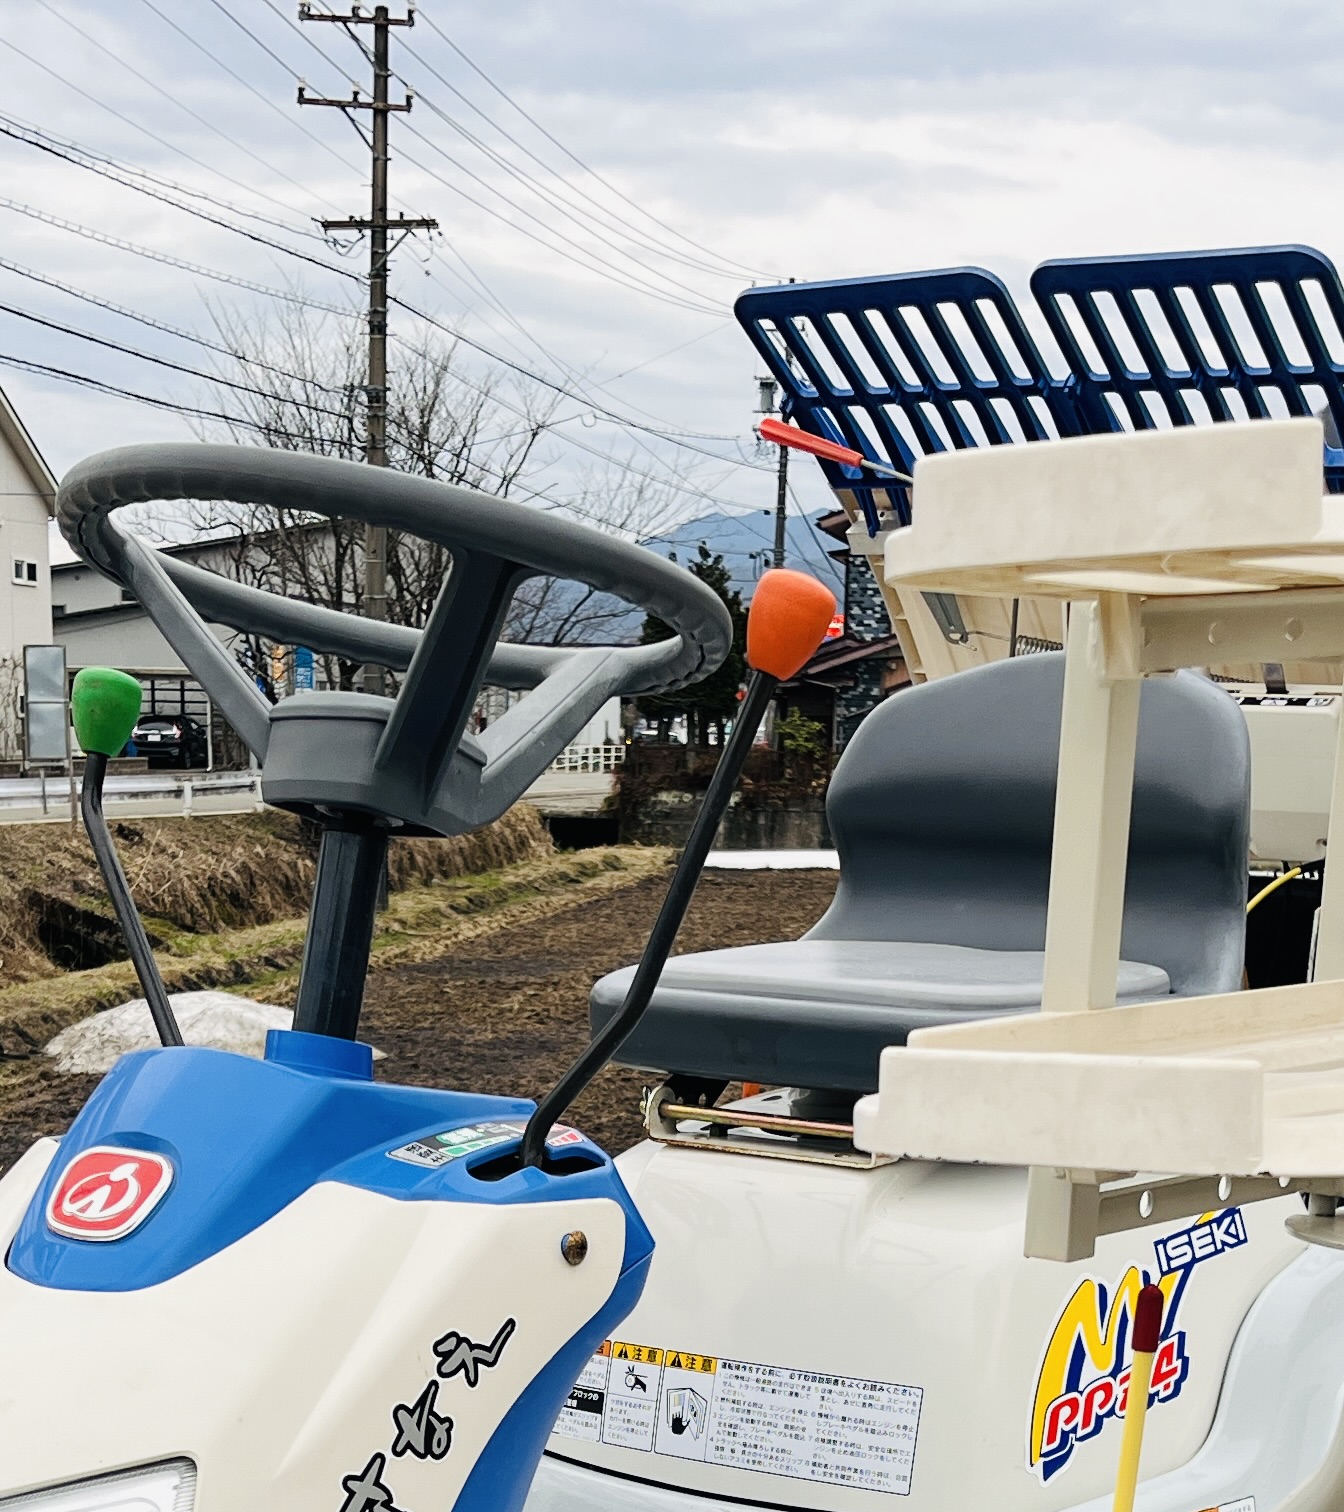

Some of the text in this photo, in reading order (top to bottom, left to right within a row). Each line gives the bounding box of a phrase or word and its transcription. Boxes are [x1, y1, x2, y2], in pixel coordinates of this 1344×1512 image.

[1155, 1212, 1247, 1274] ISEKI
[632, 1345, 657, 1364] 注意
[684, 1354, 713, 1372] 注意
